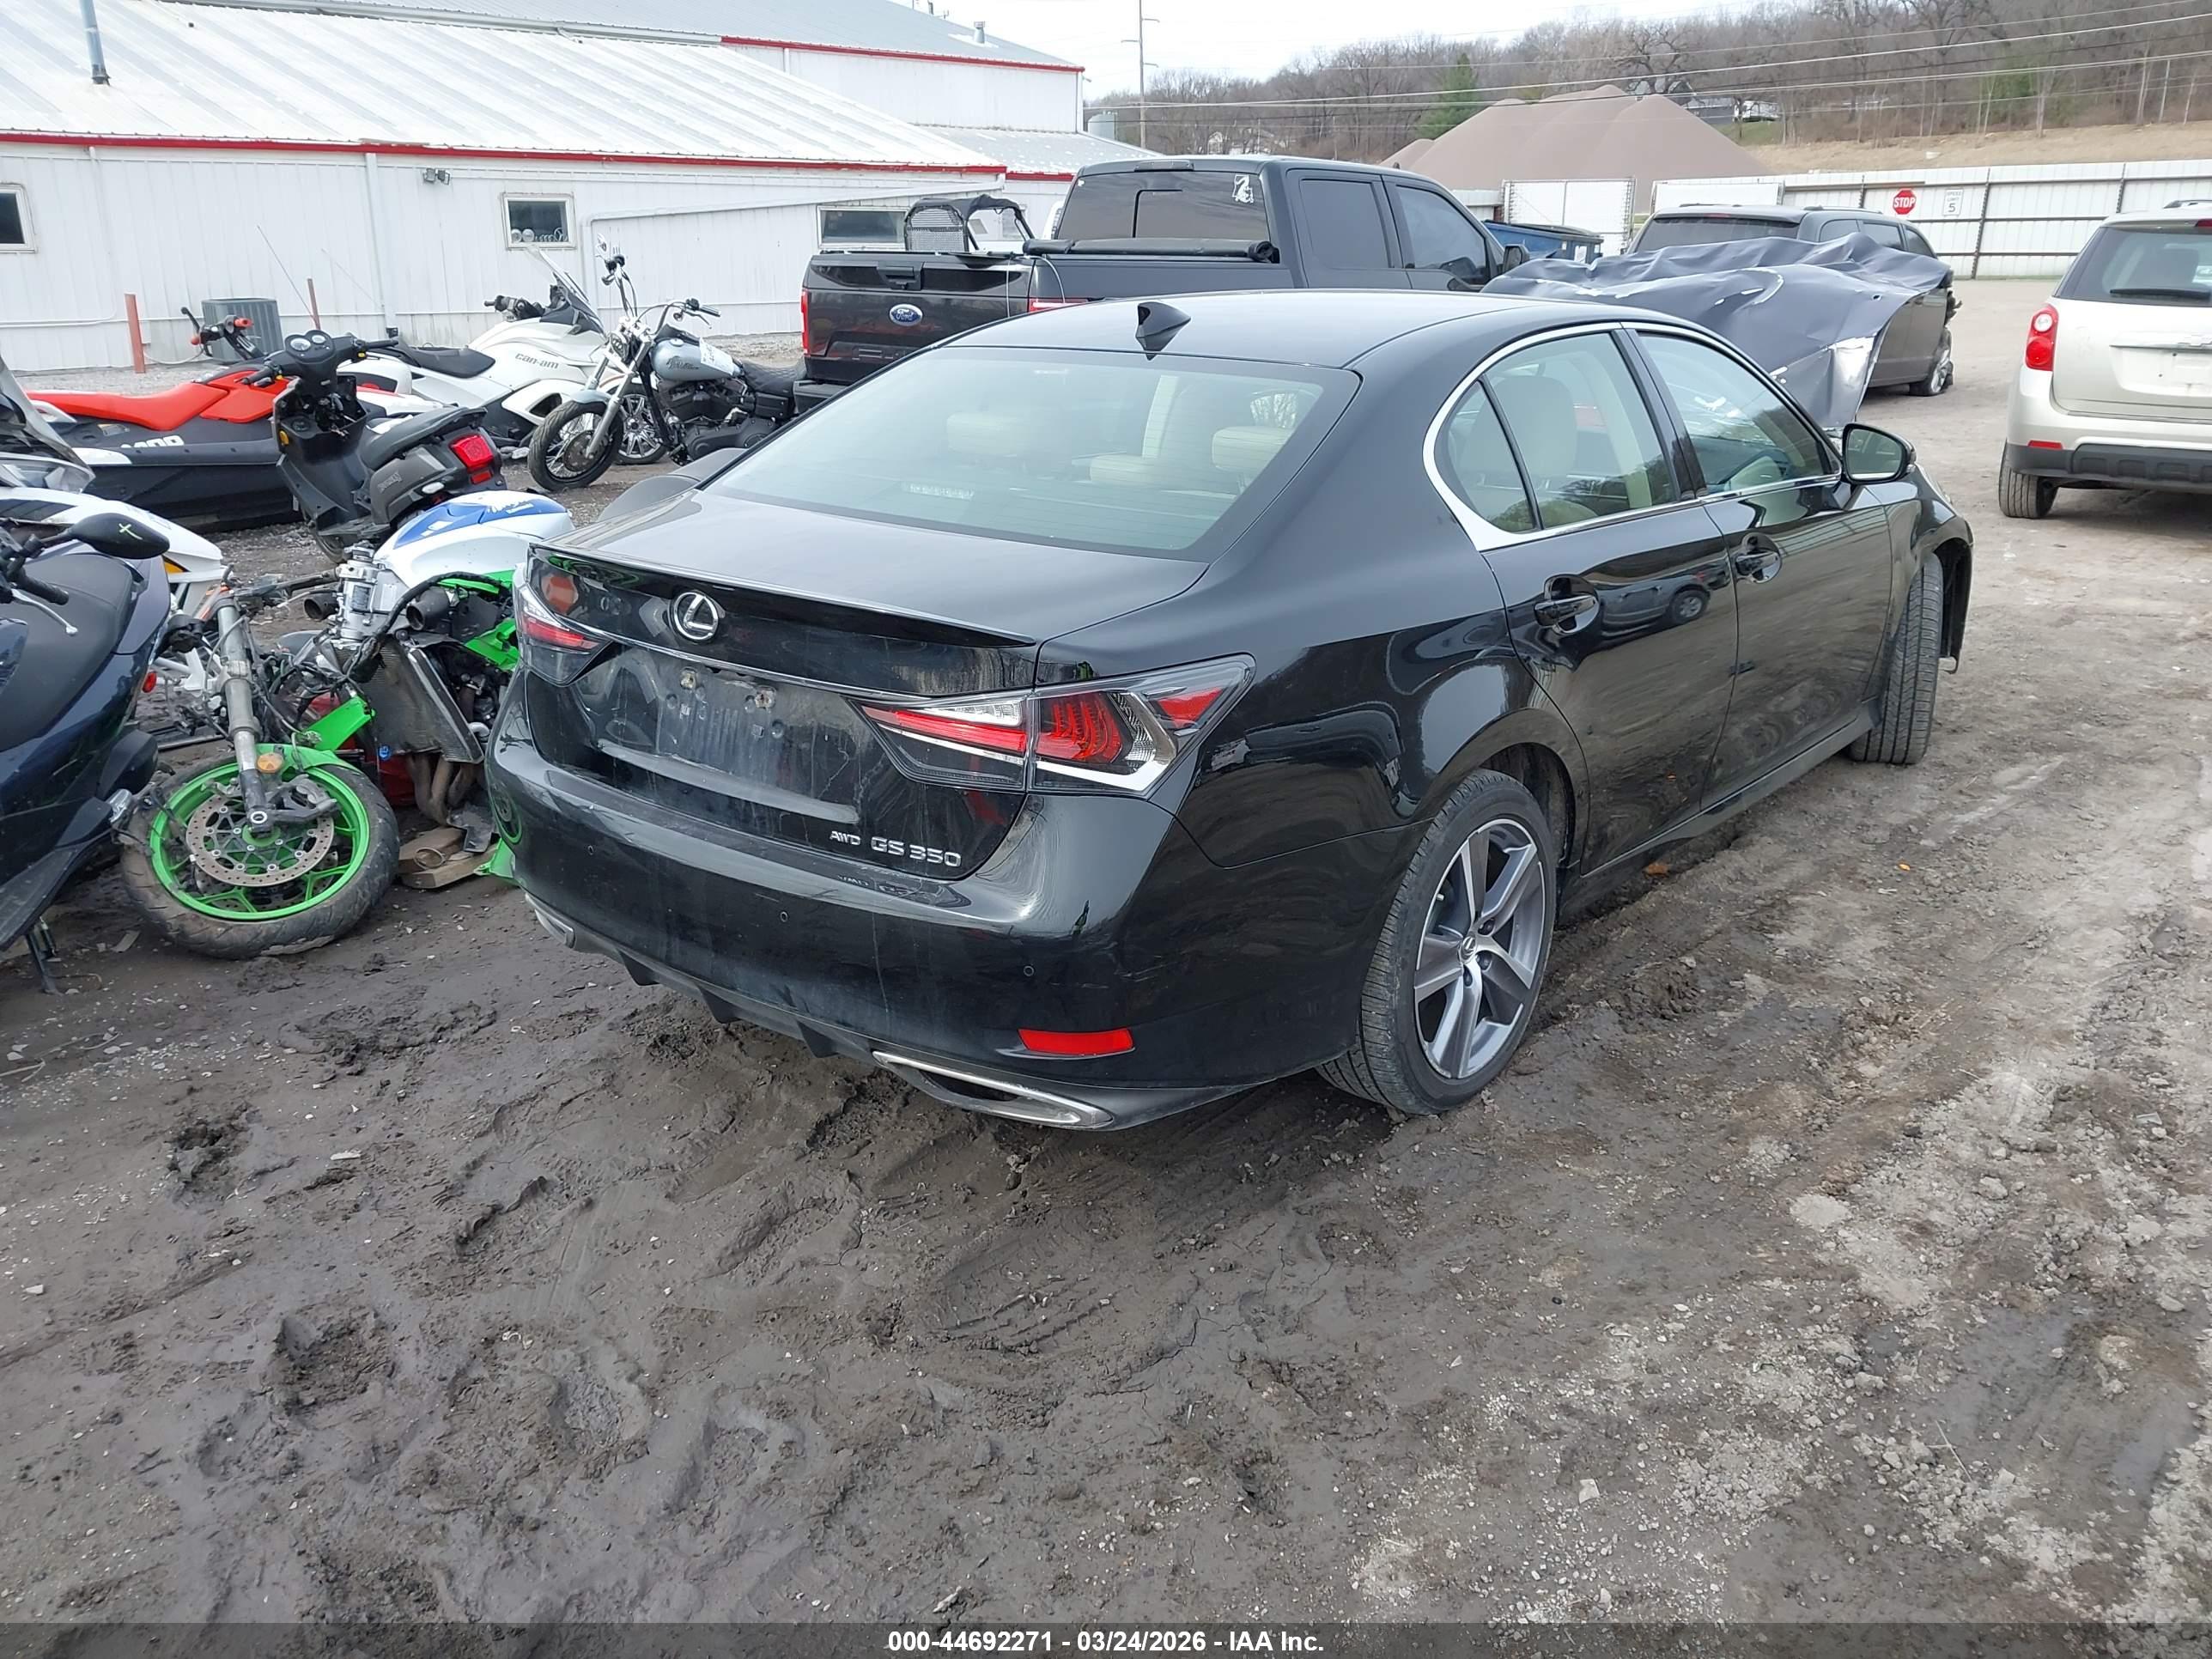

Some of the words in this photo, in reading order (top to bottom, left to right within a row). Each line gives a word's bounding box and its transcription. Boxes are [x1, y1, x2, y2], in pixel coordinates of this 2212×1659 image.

[1893, 197, 1916, 209] STOP
[1948, 203, 1956, 213] 5
[896, 307, 915, 321] Ford
[515, 353, 559, 369] can-am
[830, 830, 861, 846] AWD
[871, 836, 905, 856] GS
[909, 844, 962, 867] 350
